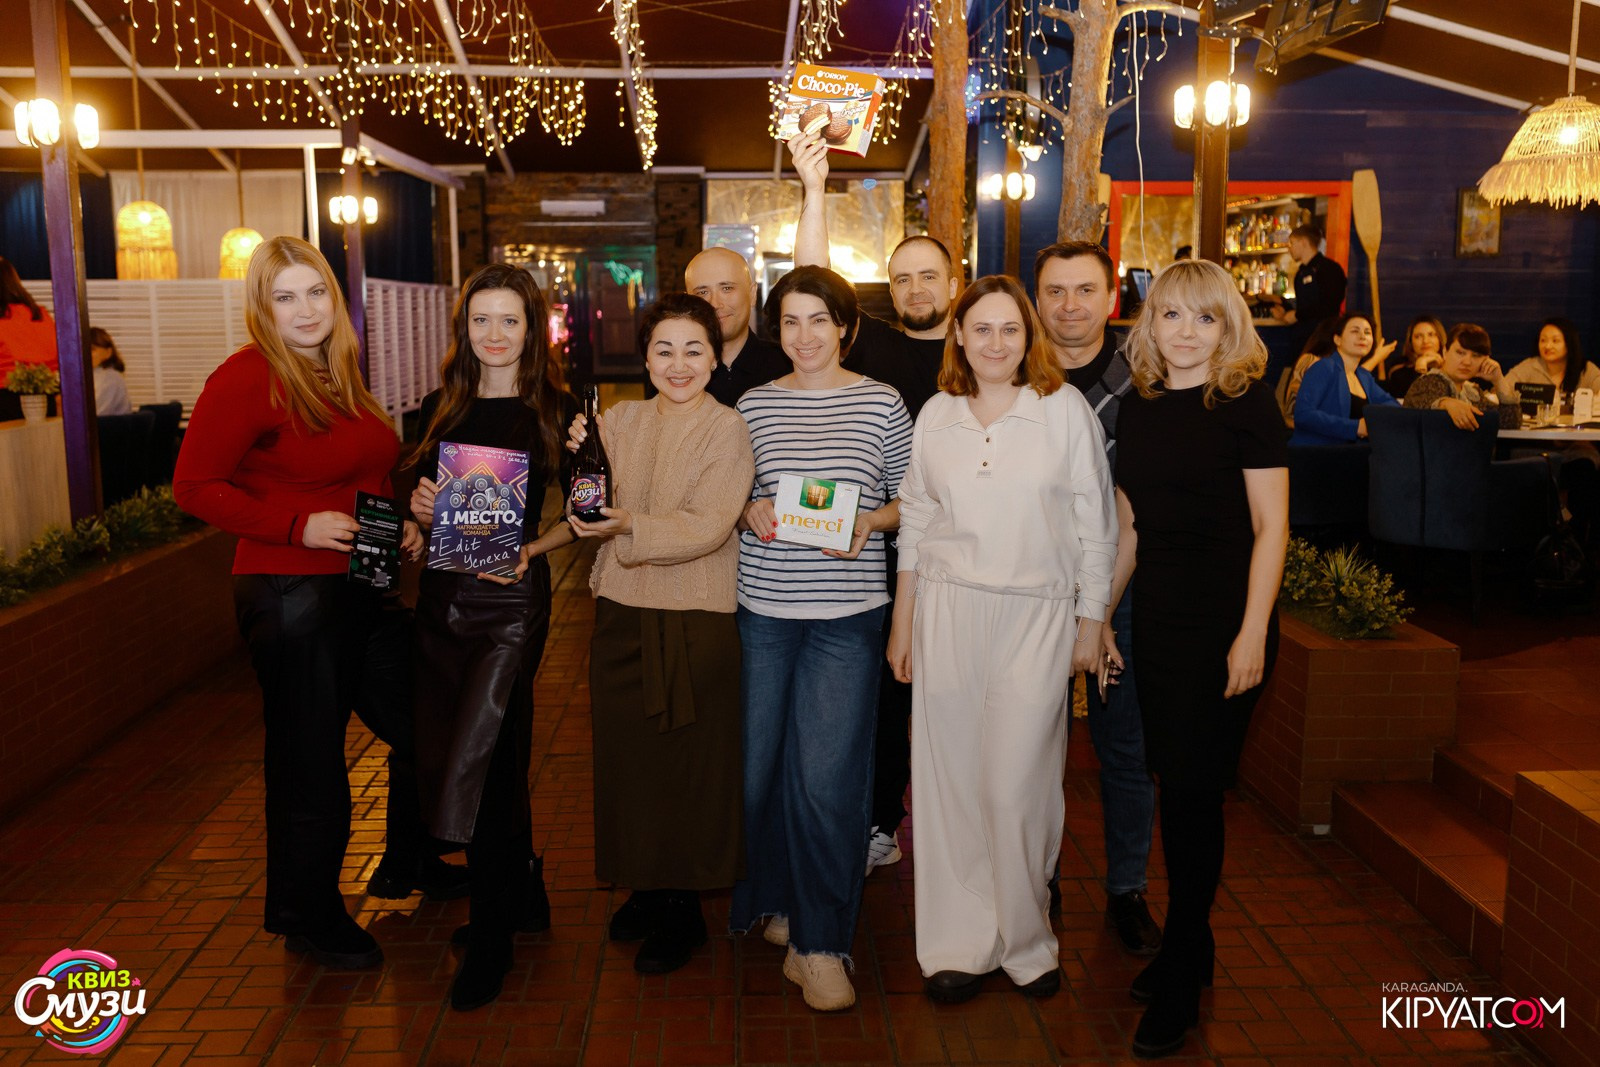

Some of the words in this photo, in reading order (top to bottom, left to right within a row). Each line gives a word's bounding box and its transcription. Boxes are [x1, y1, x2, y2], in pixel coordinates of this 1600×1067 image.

[571, 487, 600, 501] Смузи
[440, 511, 450, 525] 1
[453, 510, 516, 524] МЕСТО
[781, 513, 844, 534] merci
[439, 537, 481, 557] Edit
[463, 551, 510, 570] Успеха
